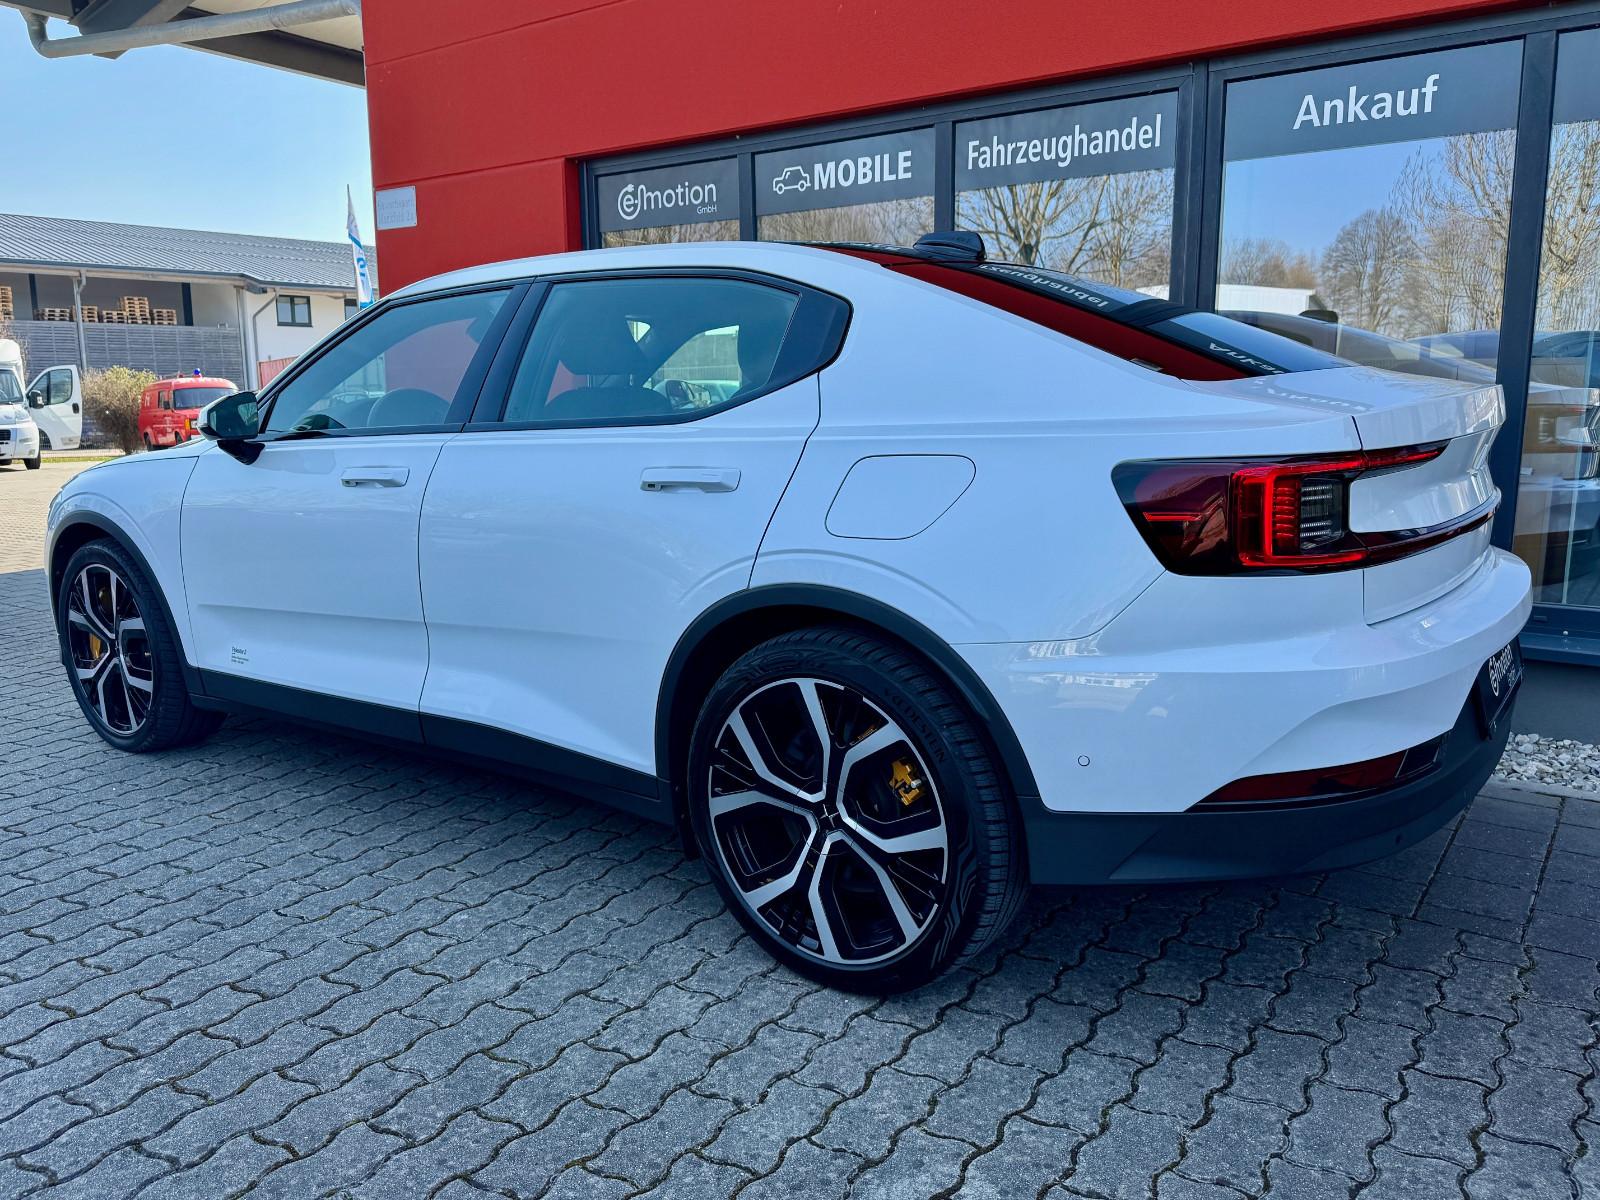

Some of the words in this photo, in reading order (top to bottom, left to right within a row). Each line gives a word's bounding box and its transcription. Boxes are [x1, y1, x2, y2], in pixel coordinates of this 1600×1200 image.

[1292, 73, 1440, 130] Ankauf
[968, 113, 1162, 170] Fahrzeughandel
[814, 150, 912, 191] MOBILE
[697, 204, 718, 215] GmbH
